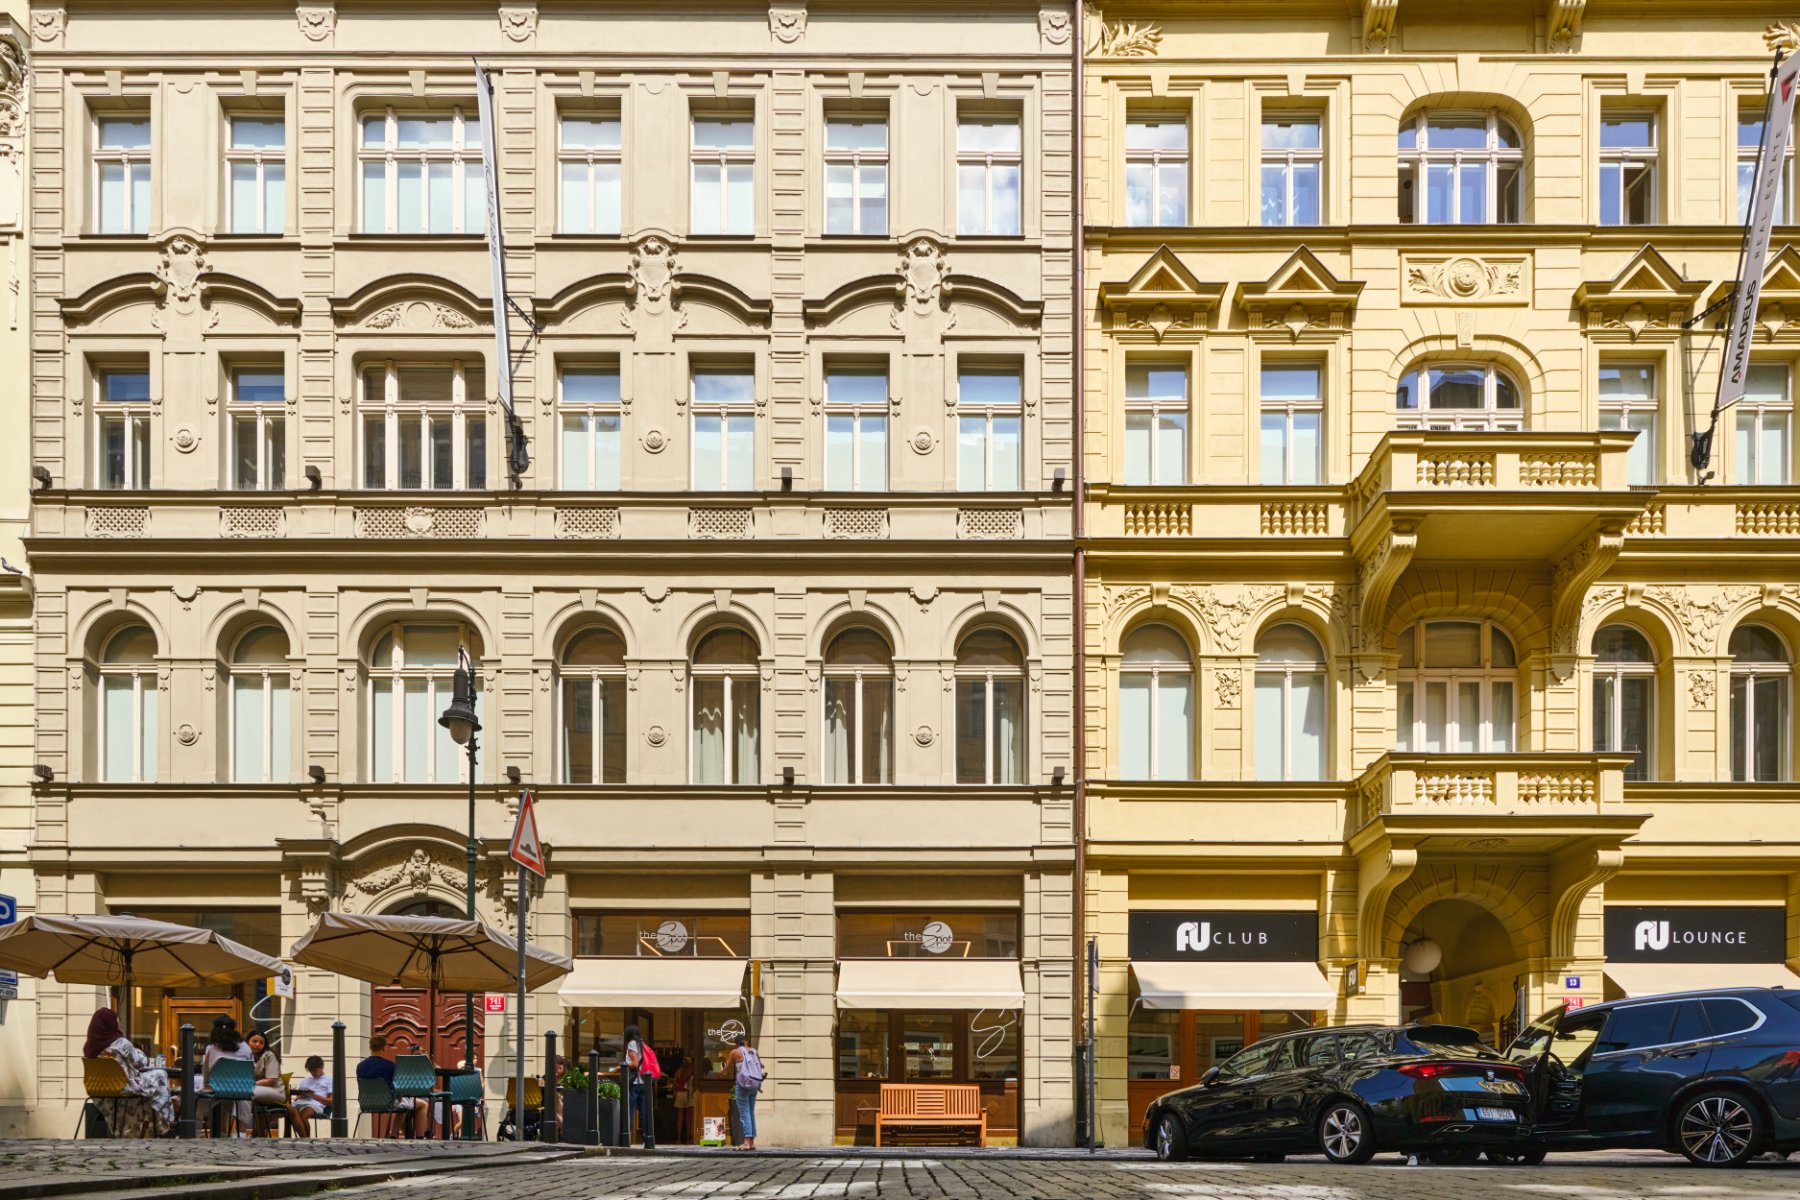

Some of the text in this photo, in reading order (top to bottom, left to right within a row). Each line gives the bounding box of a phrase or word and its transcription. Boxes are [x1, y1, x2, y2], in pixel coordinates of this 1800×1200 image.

[1731, 129, 1782, 384] AMADEUS REAL ESTATE
[640, 930, 657, 939] the
[904, 931, 922, 941] the
[1213, 932, 1268, 945] CLUB
[1673, 931, 1747, 944] LOUNGE
[707, 1028, 721, 1036] the
